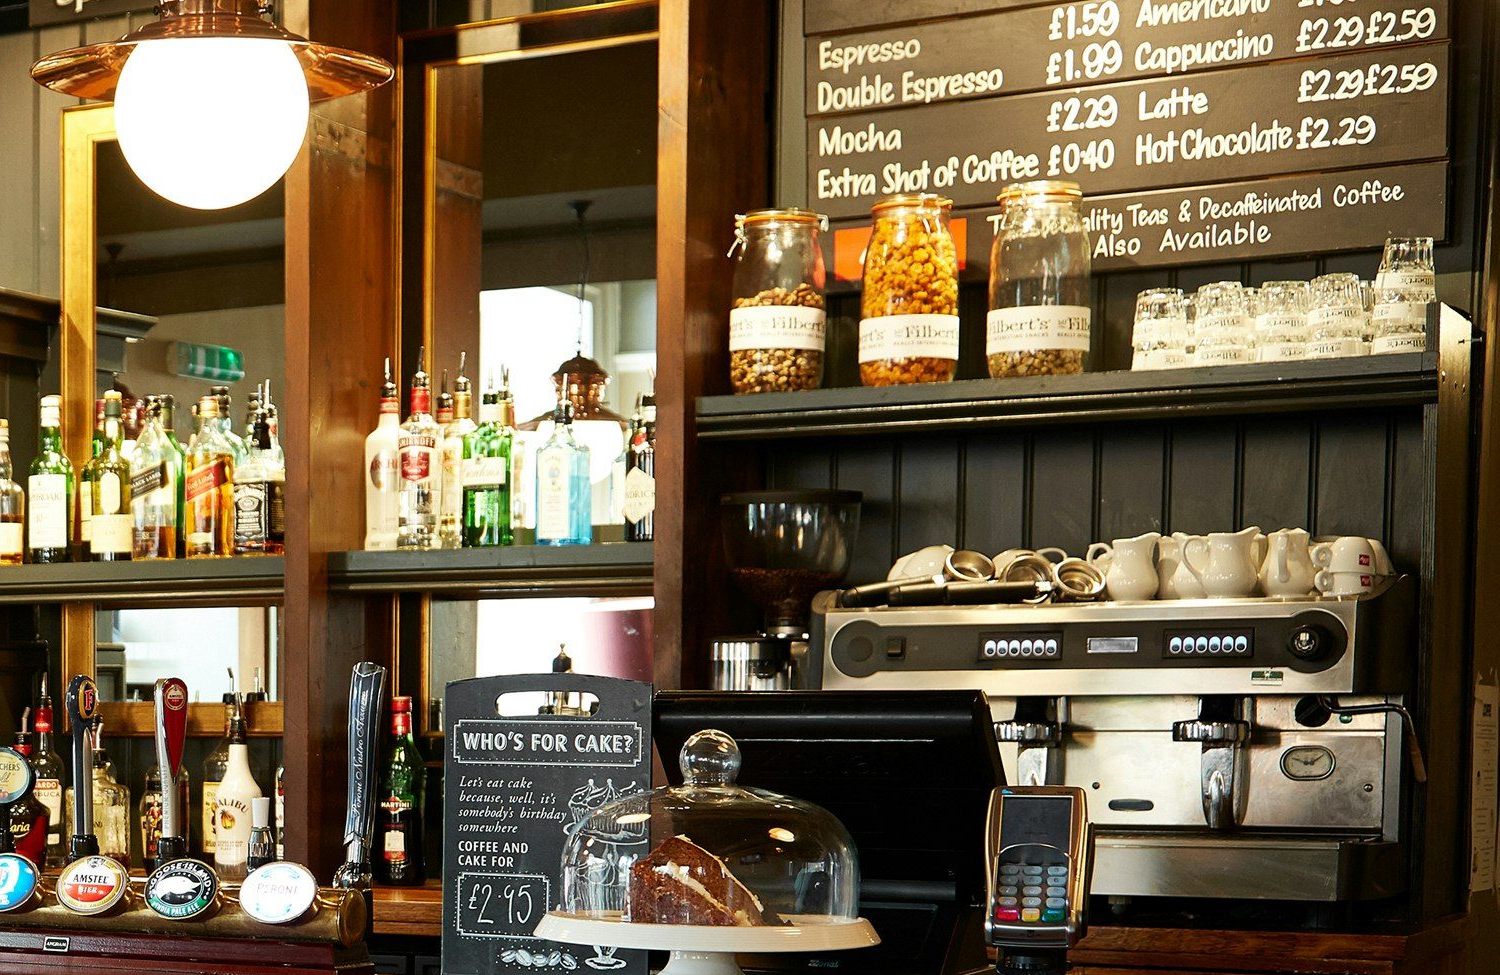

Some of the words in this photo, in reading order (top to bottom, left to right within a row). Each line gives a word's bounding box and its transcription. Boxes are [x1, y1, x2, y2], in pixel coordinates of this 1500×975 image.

[818, 39, 921, 75] Espresso
[1048, 0, 1120, 41] £1.59
[1134, 29, 1274, 74] Cappuccino
[1295, 15, 1365, 53] £2.29
[1364, 7, 1437, 46] £2.59
[817, 74, 895, 113] Double
[901, 68, 1004, 104] Espresso
[1046, 39, 1124, 85] £1.99
[1138, 86, 1209, 121] Latte
[1297, 68, 1364, 103] £2.29
[1363, 62, 1438, 95] £2.59
[818, 123, 902, 157] Mocha
[1046, 94, 1119, 133] £2.29
[1135, 131, 1180, 166] Hot
[1180, 119, 1294, 161] Chocolate
[1296, 114, 1377, 150] £2.29
[817, 167, 878, 199] Extra
[881, 159, 931, 195] Shot
[933, 156, 960, 187] of
[962, 149, 1040, 185] Coffee
[1127, 203, 1169, 229] Teas
[1178, 199, 1192, 223] &
[1199, 186, 1323, 221] Decaffeinated
[1333, 179, 1405, 208] Coffee
[1093, 233, 1142, 259] Also
[1159, 220, 1272, 252] Available
[463, 731, 524, 752] WHO'S
[531, 734, 567, 753] FOR
[574, 735, 634, 754] CAKE?
[354, 738, 365, 781] Nastro
[459, 776, 483, 788] Let's
[486, 778, 504, 788] eat
[507, 777, 533, 789] cake
[352, 780, 364, 819] Peroni
[381, 801, 410, 809] MARTINI
[458, 792, 504, 804] because,
[509, 793, 535, 805] well,
[540, 793, 556, 805] it's
[9, 819, 31, 832] aria
[458, 806, 514, 821] somebody's
[520, 807, 567, 823] birthday
[458, 821, 518, 833] somewhere
[458, 841, 499, 853] COFFEE
[502, 842, 529, 854] AND
[458, 855, 487, 867] CAKE
[491, 855, 514, 867] FOR
[73, 873, 108, 884] AMSTEL
[149, 862, 182, 890] GOOSE
[182, 862, 212, 888] ISLAND
[257, 884, 299, 896] PERONI
[170, 908, 187, 916] PALE
[187, 902, 200, 914] ALE
